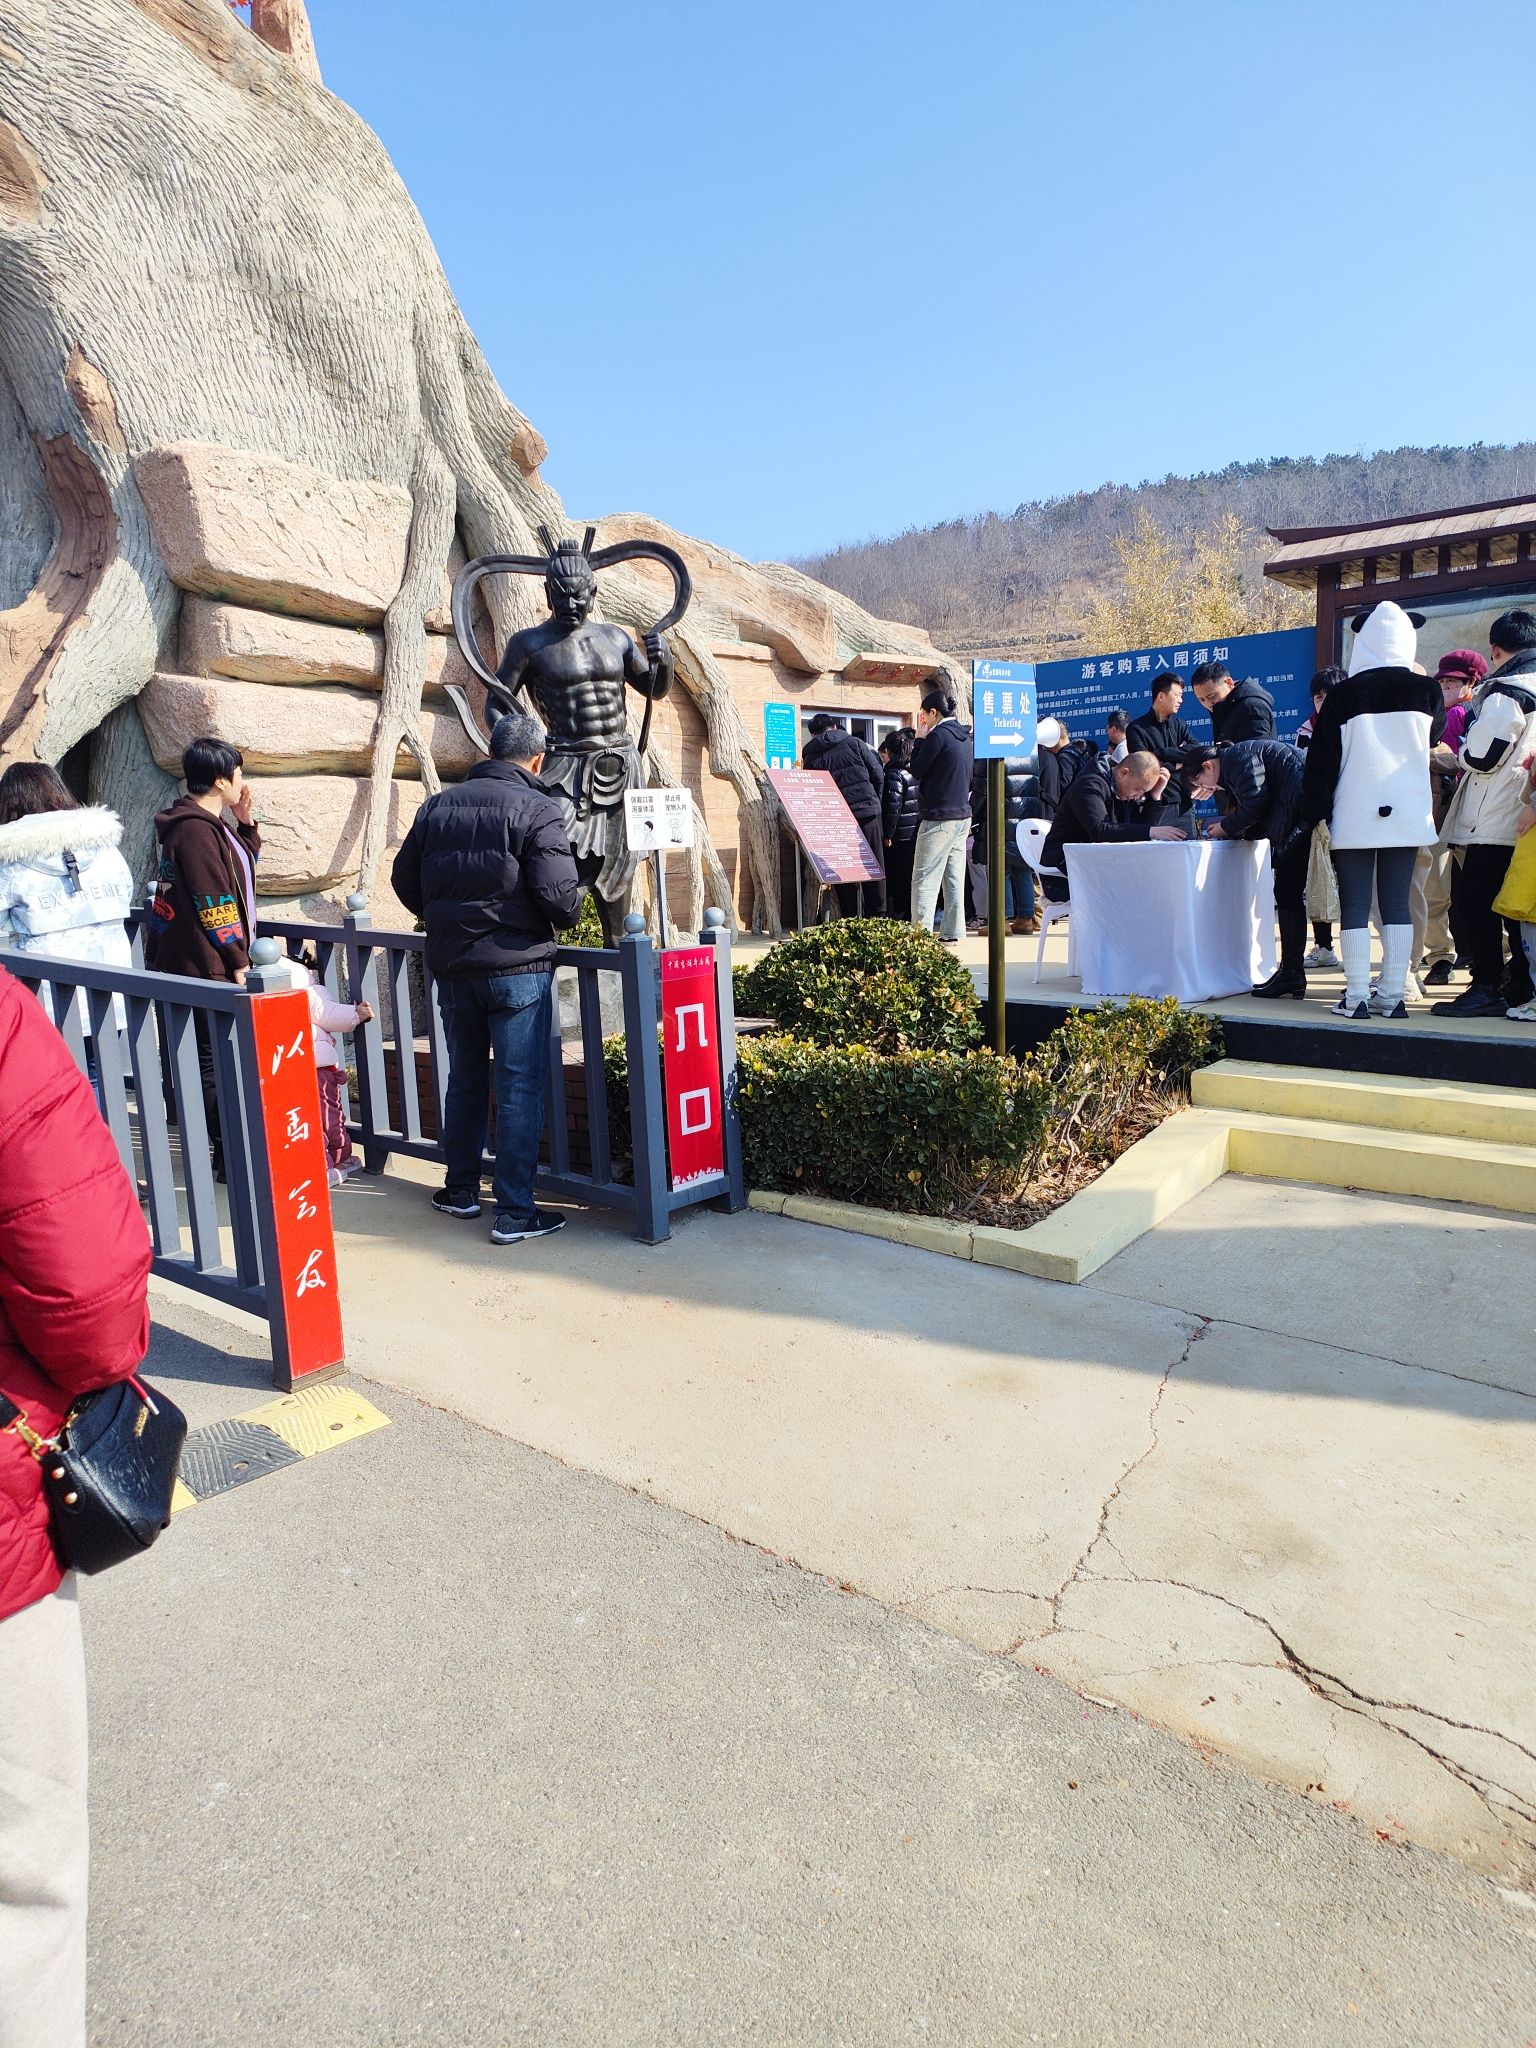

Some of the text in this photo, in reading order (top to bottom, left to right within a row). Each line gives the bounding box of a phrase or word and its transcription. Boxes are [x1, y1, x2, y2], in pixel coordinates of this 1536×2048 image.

[1081, 646, 1229, 679] 游客购票入园须知
[982, 690, 1031, 715] 售票处
[993, 717, 1022, 729] Ticketing
[631, 795, 653, 804] 佩戴口罩
[631, 804, 654, 814] 测量体温
